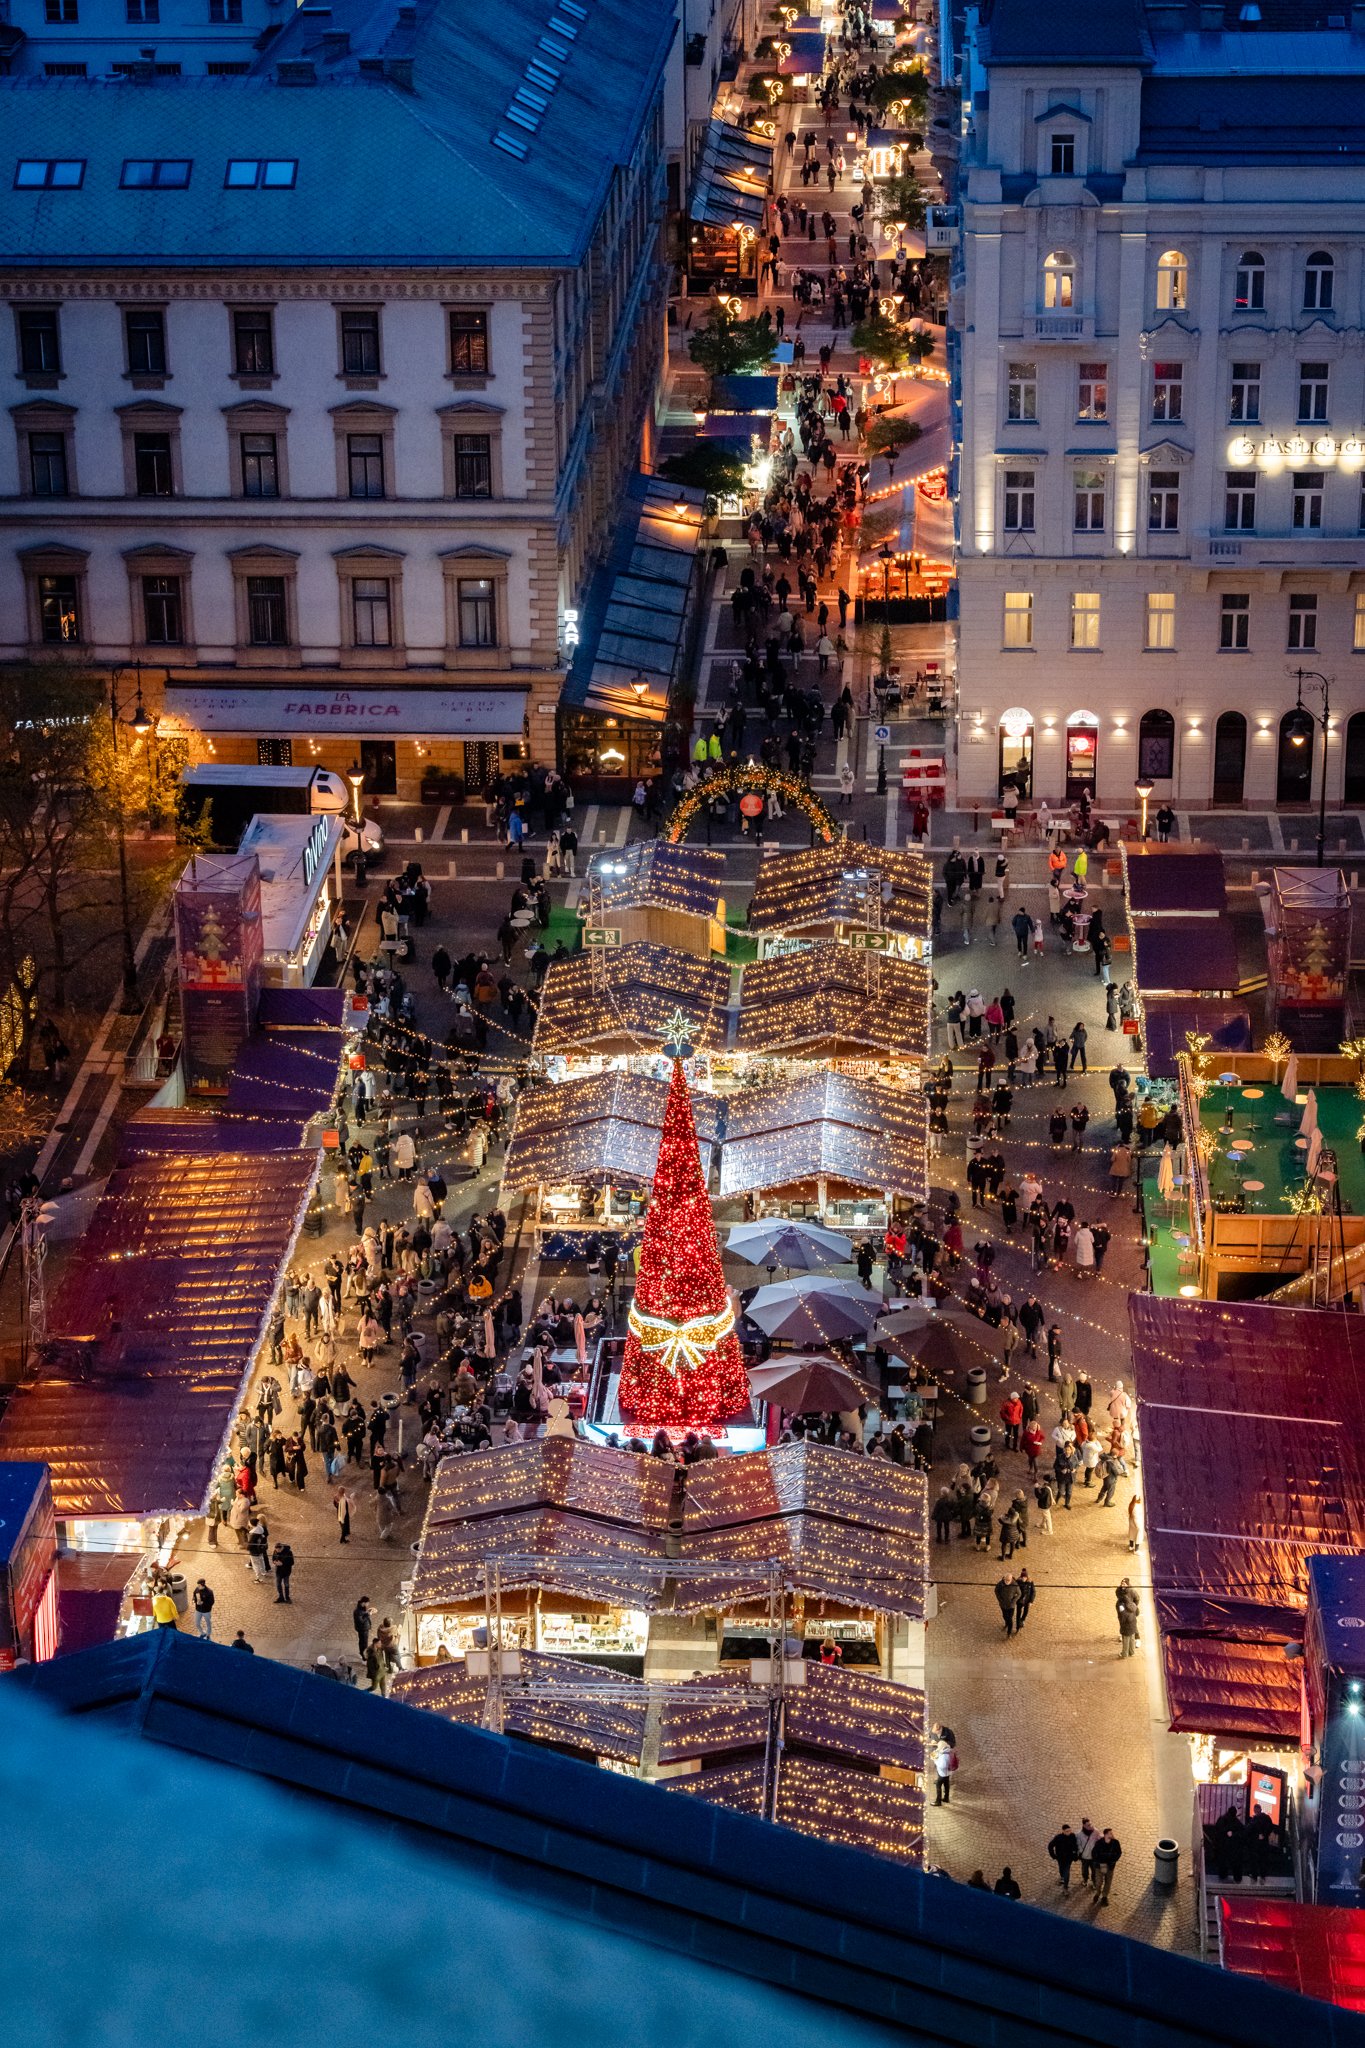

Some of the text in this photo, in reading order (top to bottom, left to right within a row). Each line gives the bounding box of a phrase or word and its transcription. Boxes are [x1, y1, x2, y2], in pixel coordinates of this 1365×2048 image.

[564, 609, 579, 645] BAR
[335, 692, 352, 702] LA
[284, 703, 401, 716] FABBRICA
